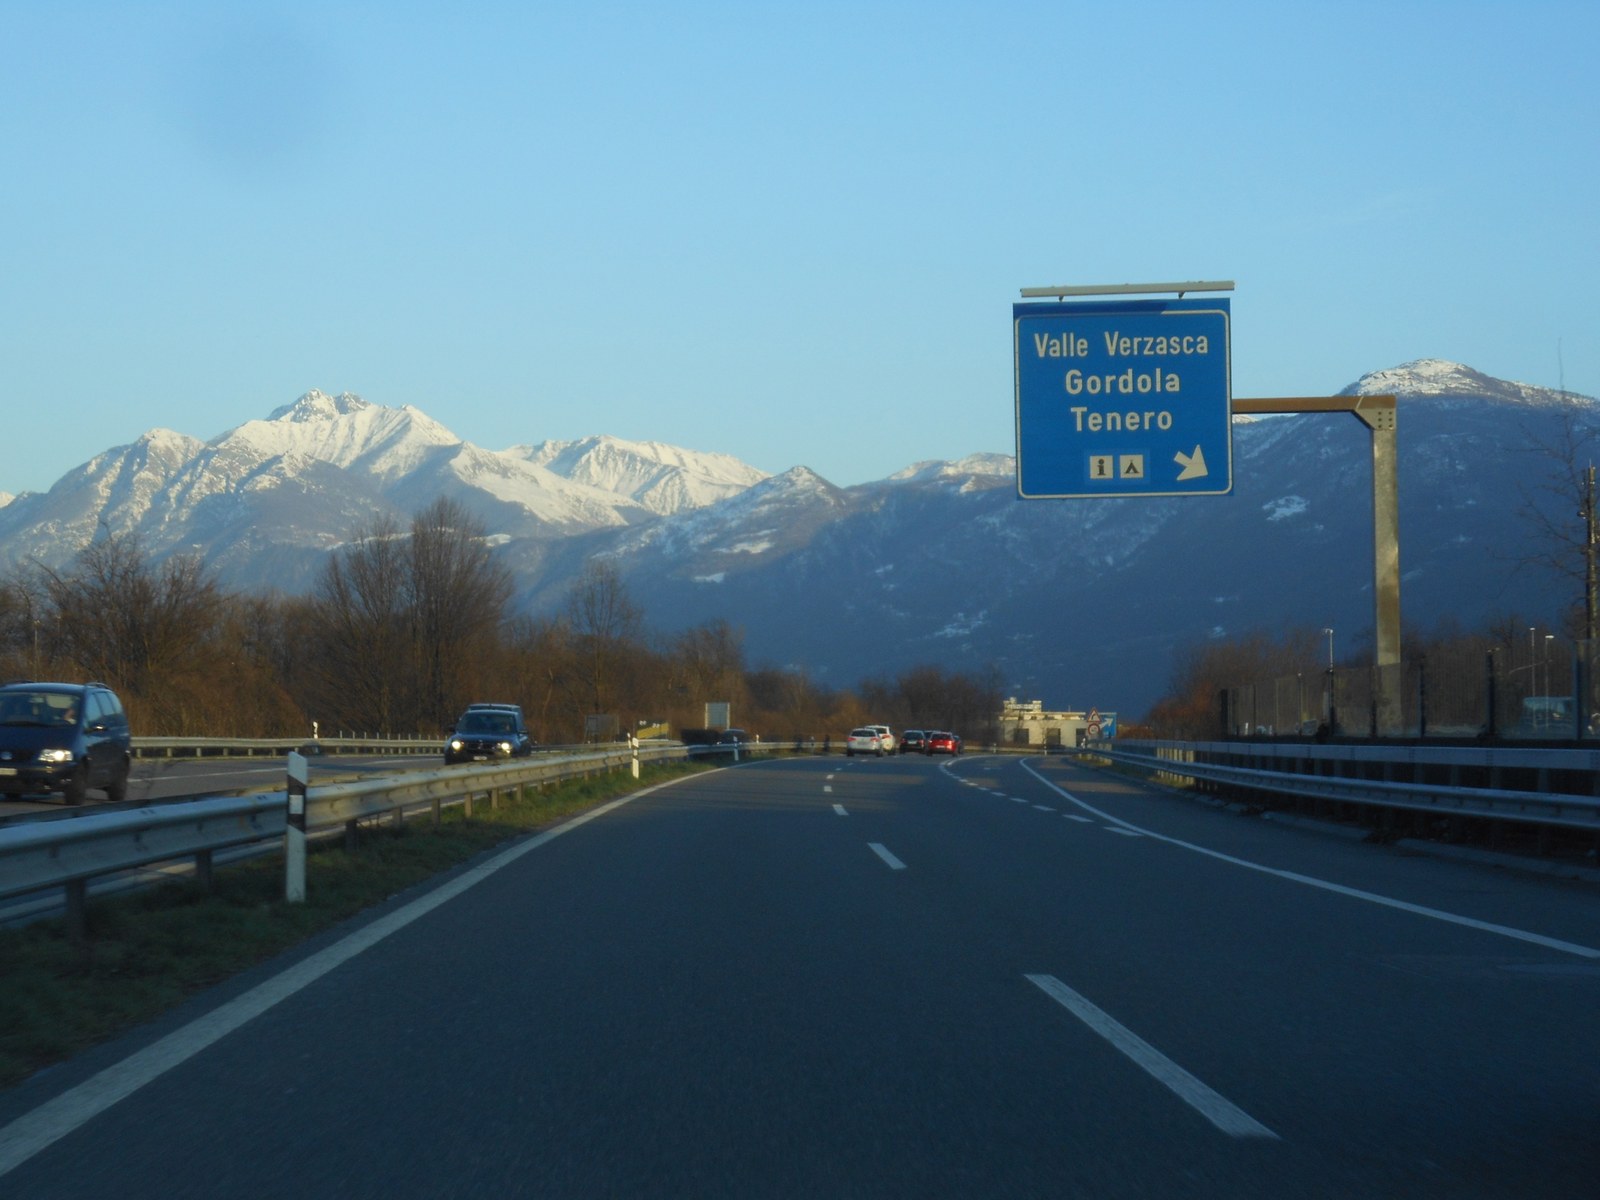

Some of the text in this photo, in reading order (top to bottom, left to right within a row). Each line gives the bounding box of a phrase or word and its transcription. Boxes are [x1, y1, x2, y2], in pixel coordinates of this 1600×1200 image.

[1034, 331, 1208, 358] Valle Verzasca
[1065, 368, 1180, 395] Gordola
[1070, 406, 1172, 432] Tenero
